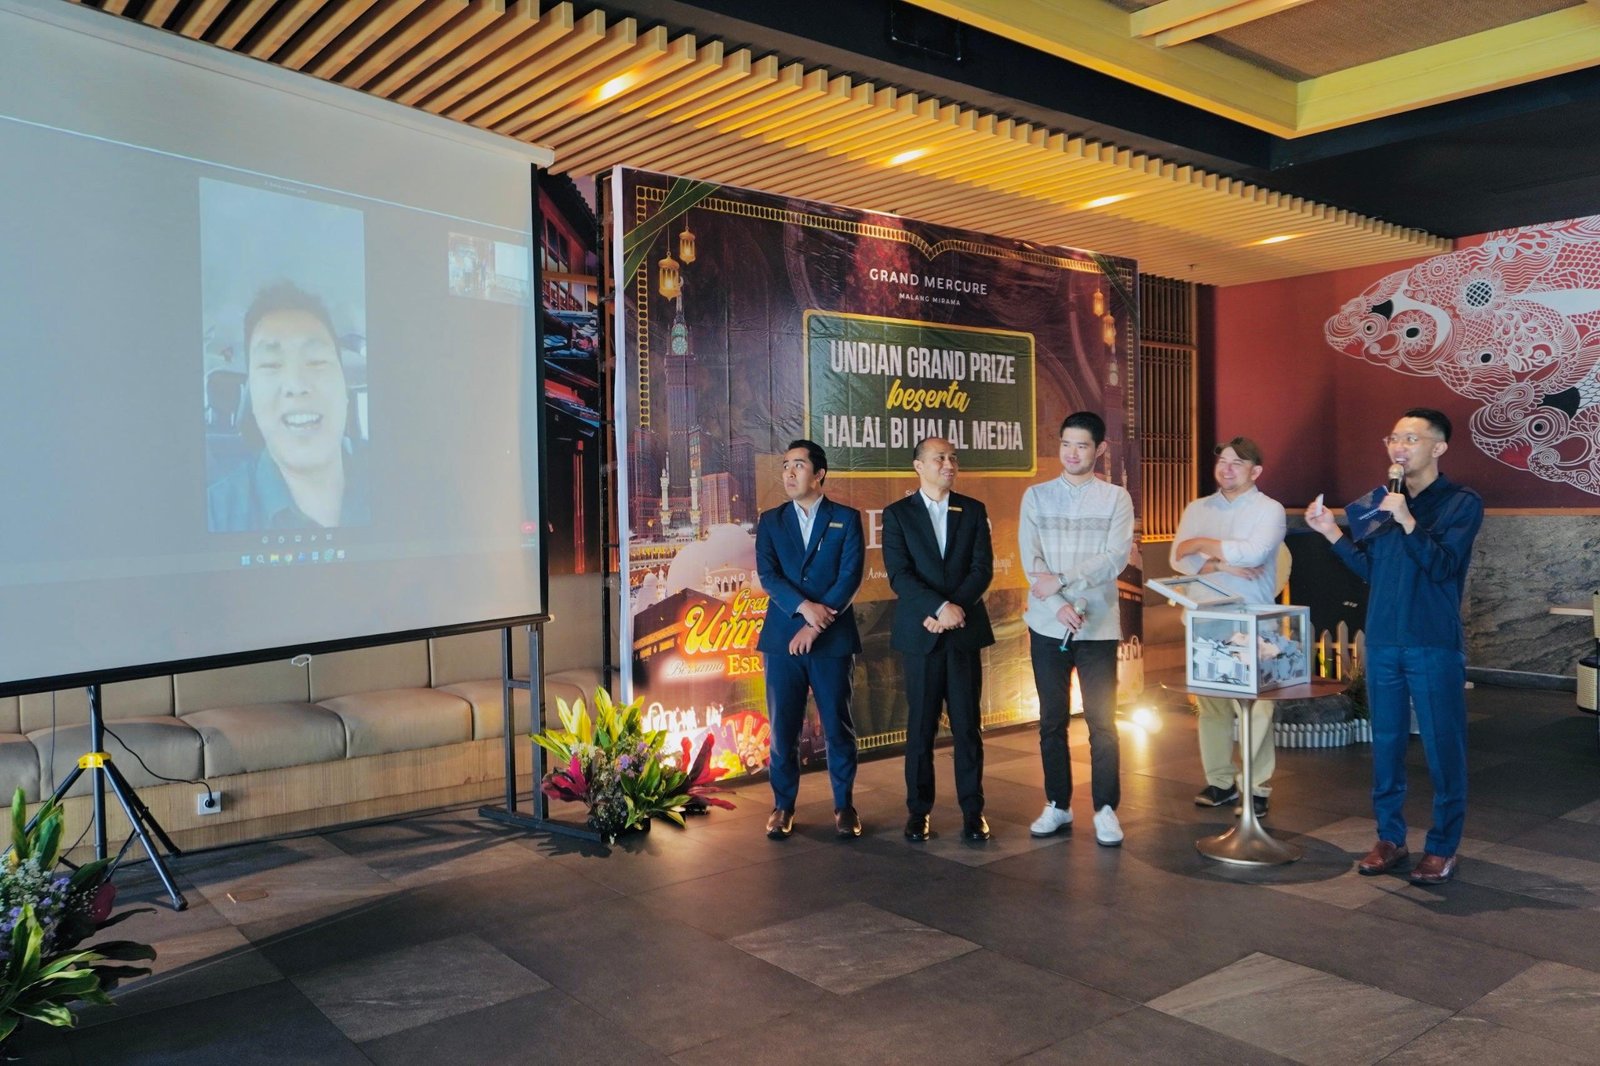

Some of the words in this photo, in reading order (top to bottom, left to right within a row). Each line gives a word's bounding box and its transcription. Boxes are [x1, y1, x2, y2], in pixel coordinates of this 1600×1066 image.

[869, 268, 919, 286] GRAND
[924, 276, 988, 295] MERCURE
[899, 293, 930, 303] MALANG
[932, 296, 961, 306] MIRAMA
[830, 340, 902, 376] UNDIAN
[907, 346, 966, 381] GRAND
[970, 352, 1016, 384] PRIZE
[886, 379, 970, 413] beserta
[823, 415, 886, 448] HALAL
[890, 417, 908, 449] BI
[972, 420, 1024, 450] MEDIA
